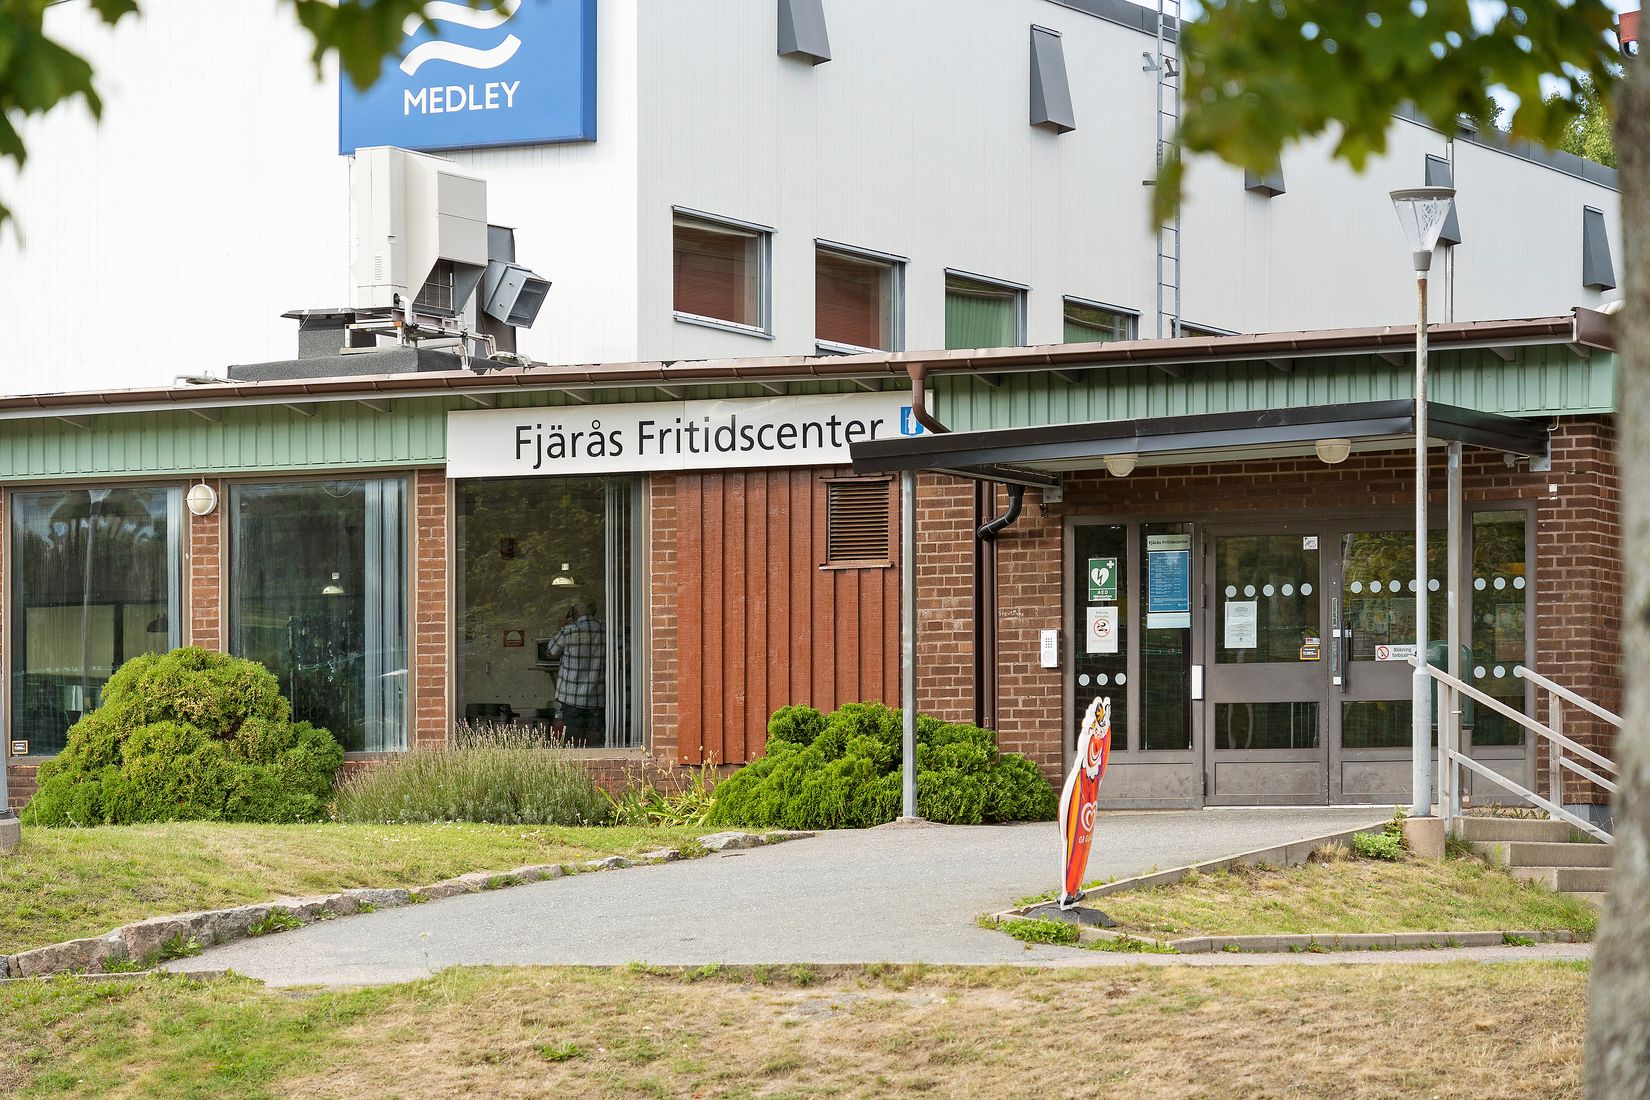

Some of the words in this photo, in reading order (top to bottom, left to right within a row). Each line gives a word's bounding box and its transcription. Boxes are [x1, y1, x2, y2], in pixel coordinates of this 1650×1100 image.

[403, 80, 521, 116] MEDLEY
[515, 419, 624, 470] Fjärås
[638, 414, 884, 455] Fritidscenter
